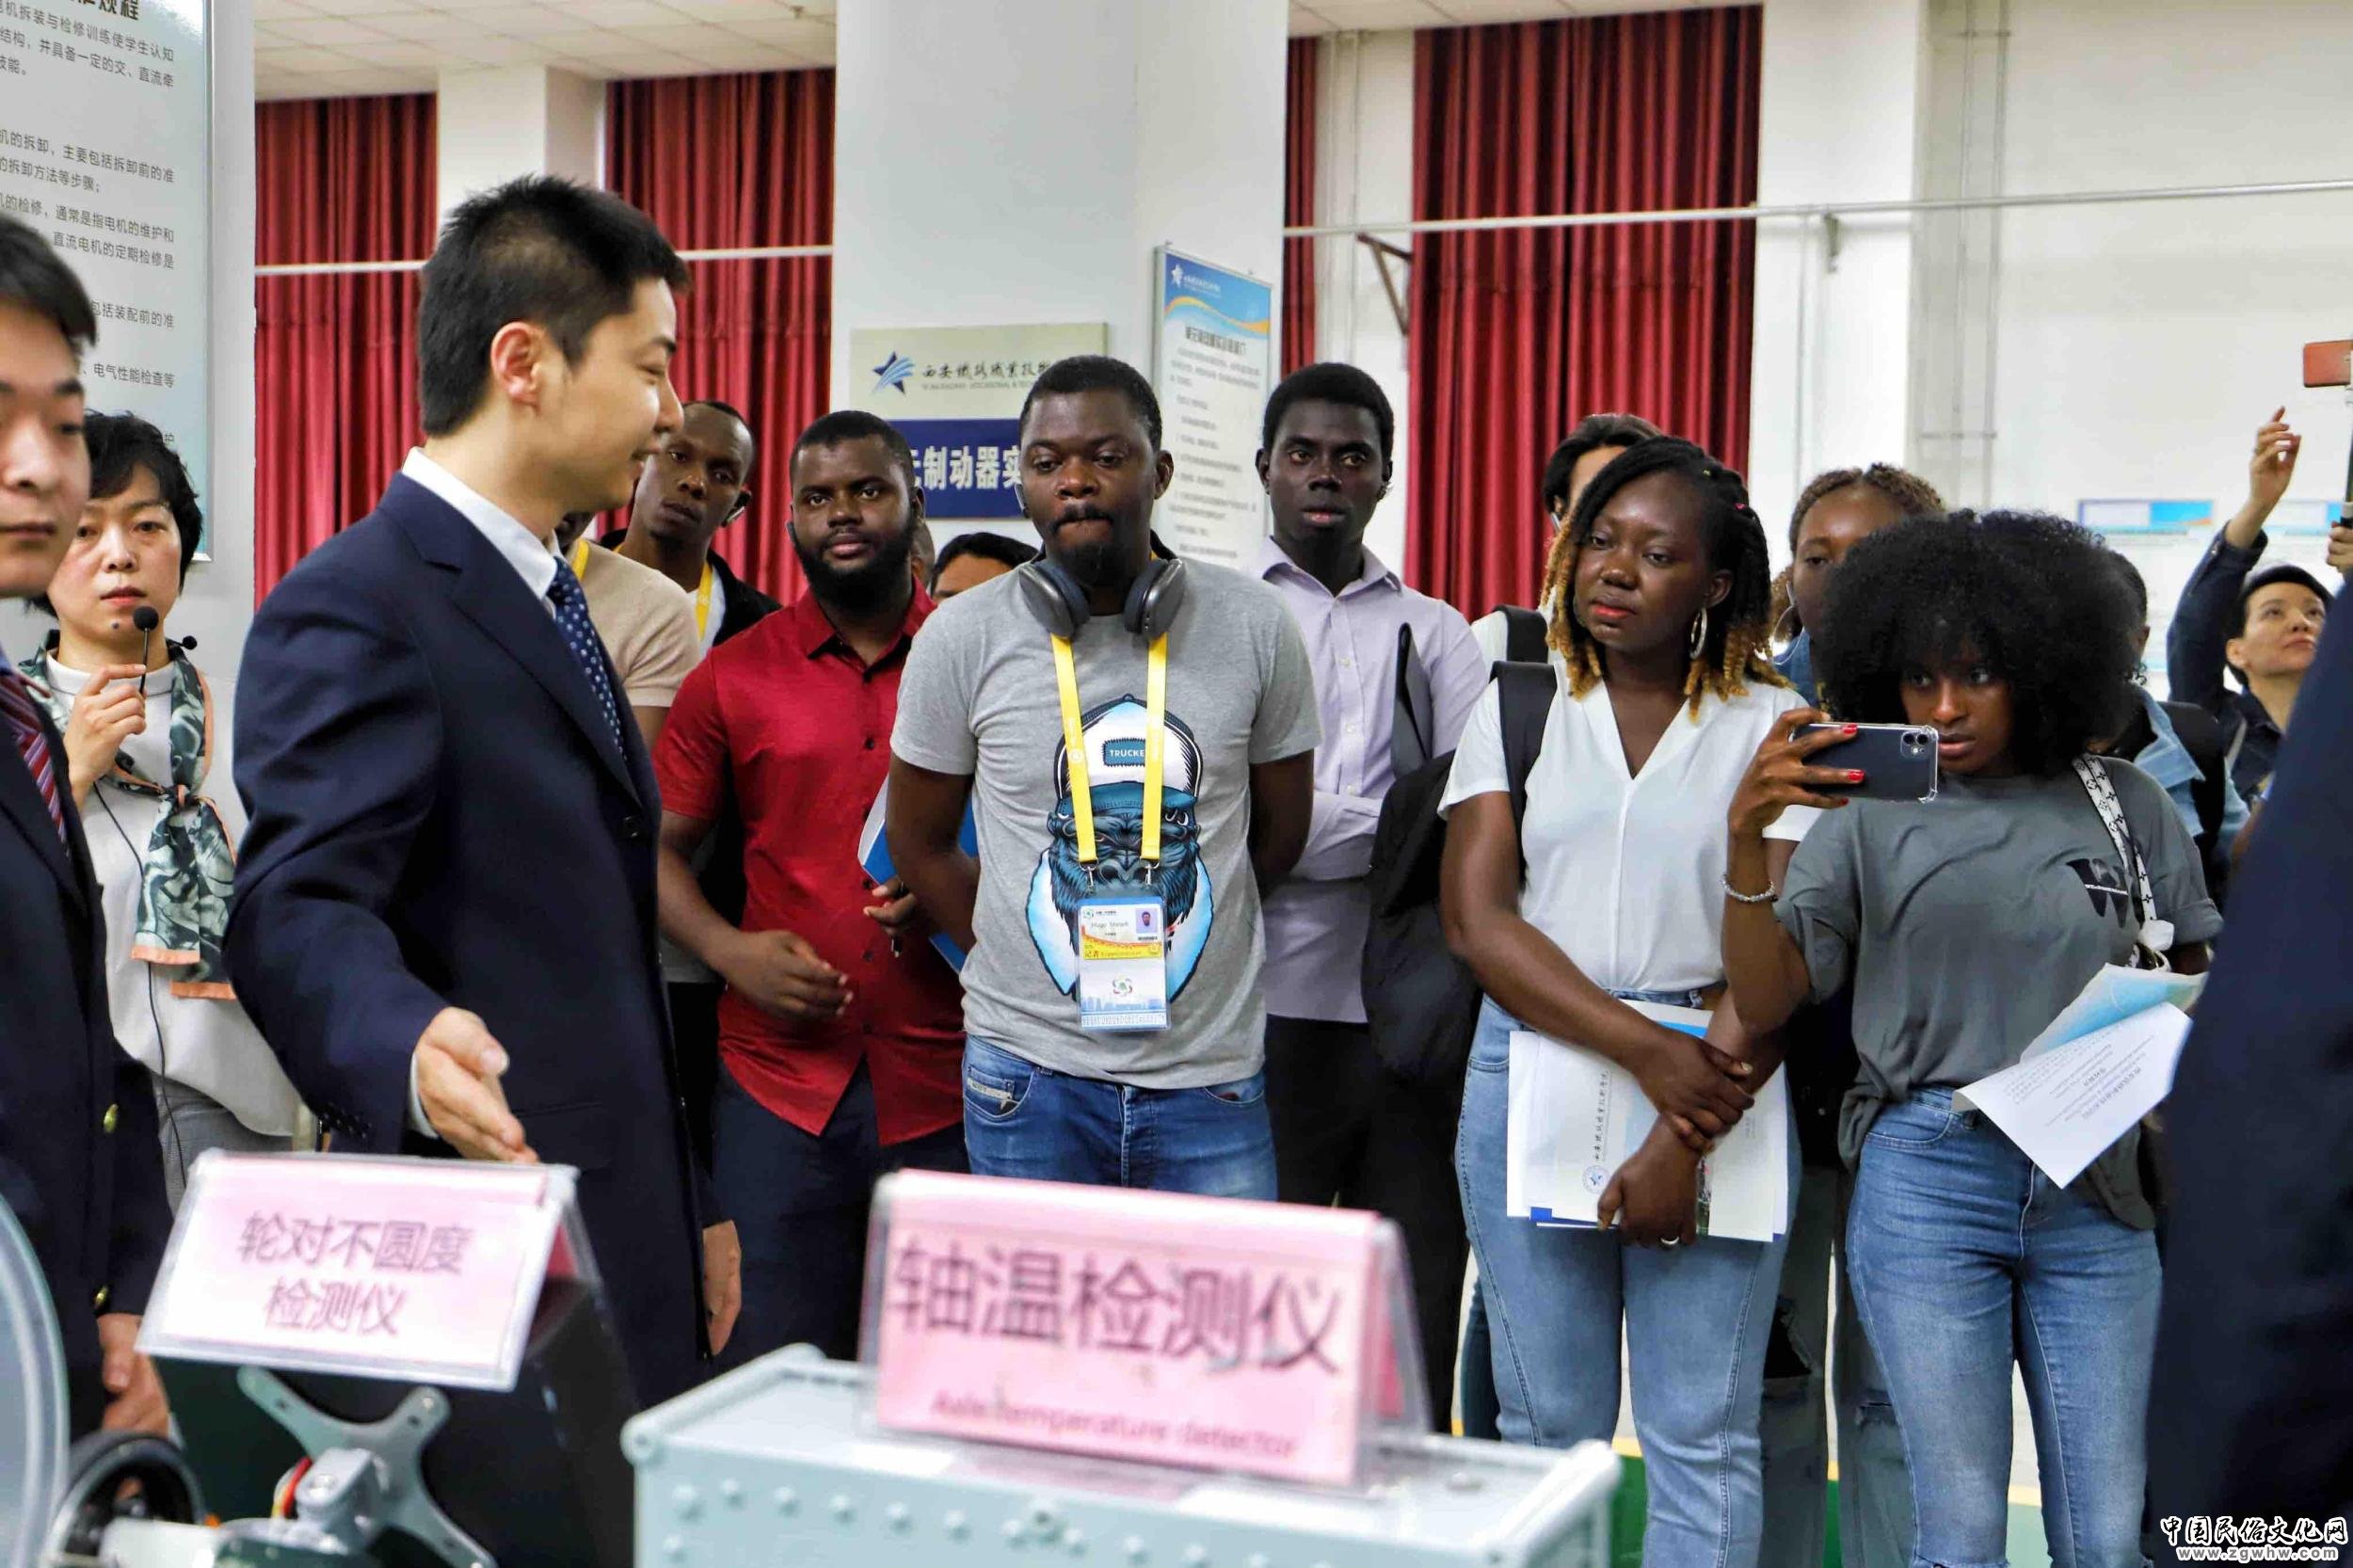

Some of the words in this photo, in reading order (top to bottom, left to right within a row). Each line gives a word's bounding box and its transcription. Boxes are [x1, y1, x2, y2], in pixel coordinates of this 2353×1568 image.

[236, 1208, 474, 1275] 轮对不圆度
[264, 1276, 408, 1336] 检测仪
[893, 1235, 1343, 1376] 轴温检测仪
